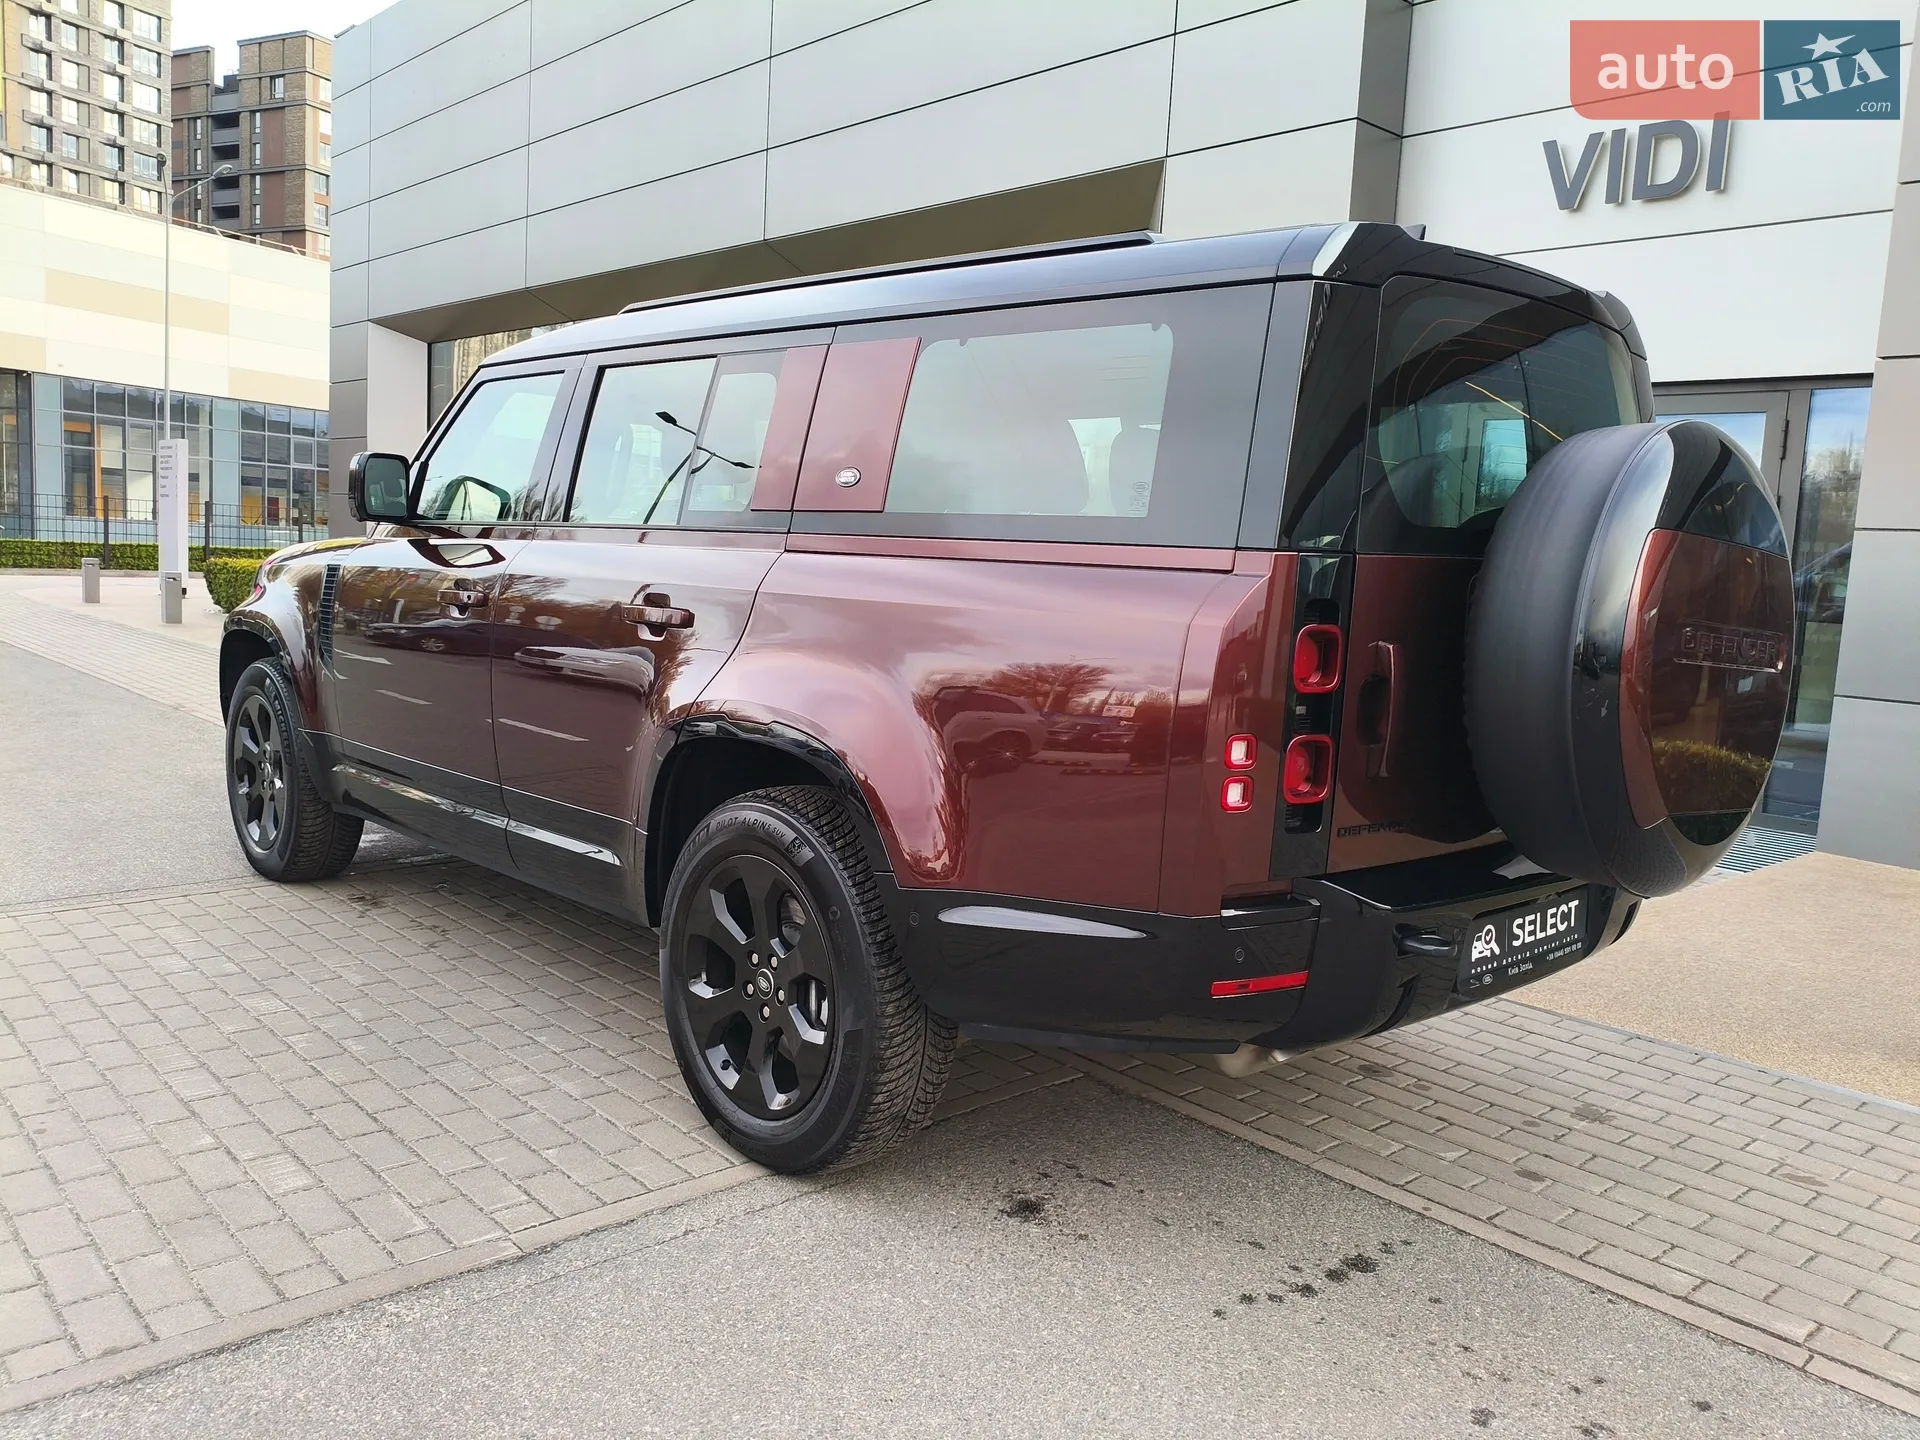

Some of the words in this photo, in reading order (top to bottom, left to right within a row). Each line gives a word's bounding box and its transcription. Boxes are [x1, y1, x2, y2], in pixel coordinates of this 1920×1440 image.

[1542, 110, 1731, 211] VIDI
[716, 817, 738, 831] PILOT
[772, 827, 786, 839] SUV
[1512, 899, 1579, 947] SELECT
